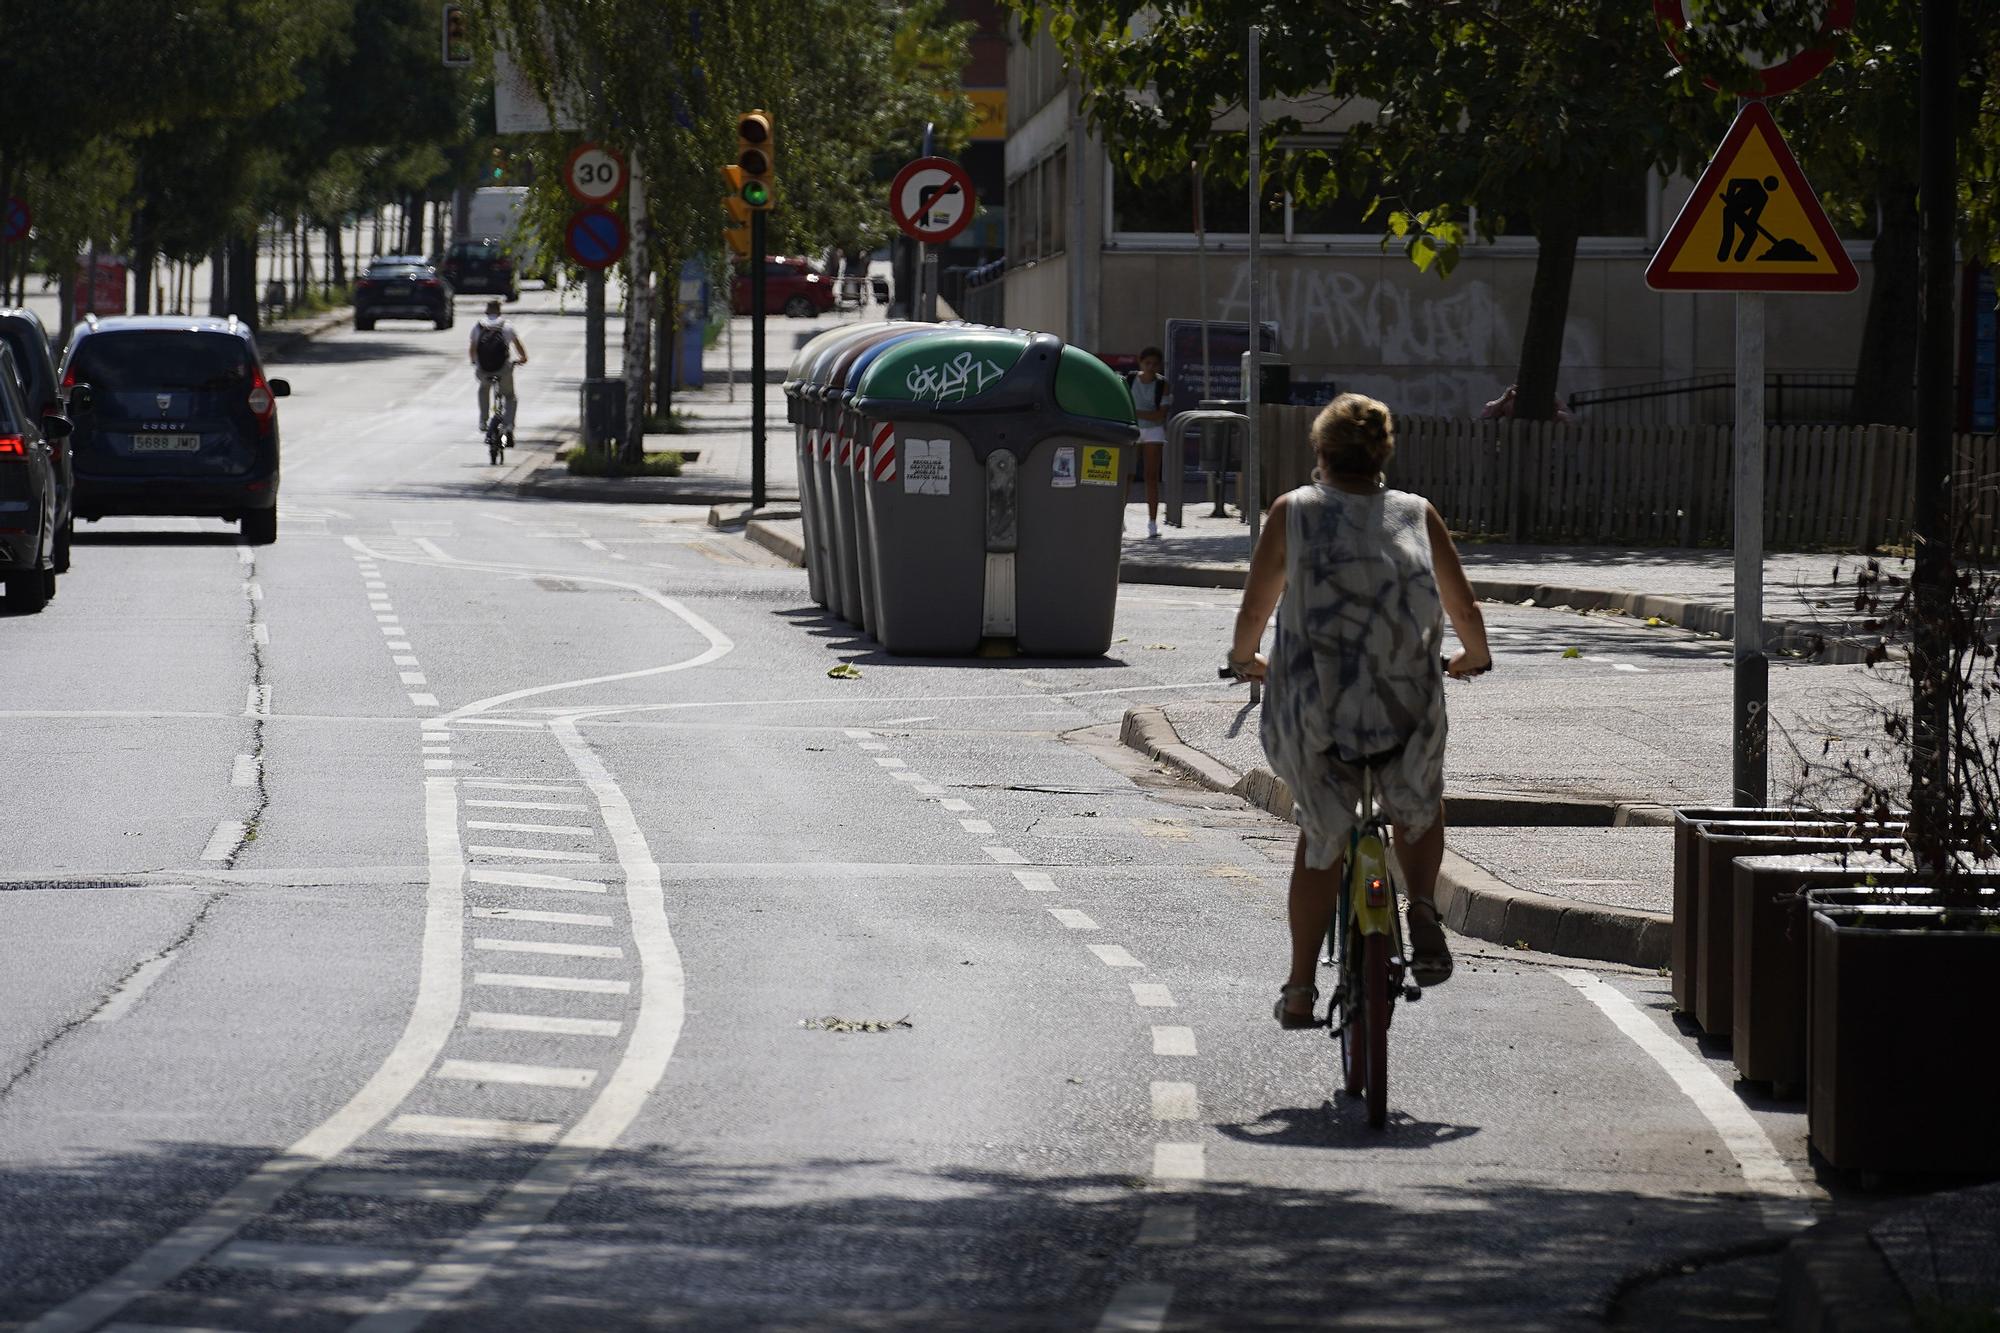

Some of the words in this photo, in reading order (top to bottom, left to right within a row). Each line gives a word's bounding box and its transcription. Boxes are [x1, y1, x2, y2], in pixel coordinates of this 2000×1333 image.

[580, 163, 613, 184] 30
[136, 437, 169, 449] 5688
[175, 437, 197, 449] JMD
